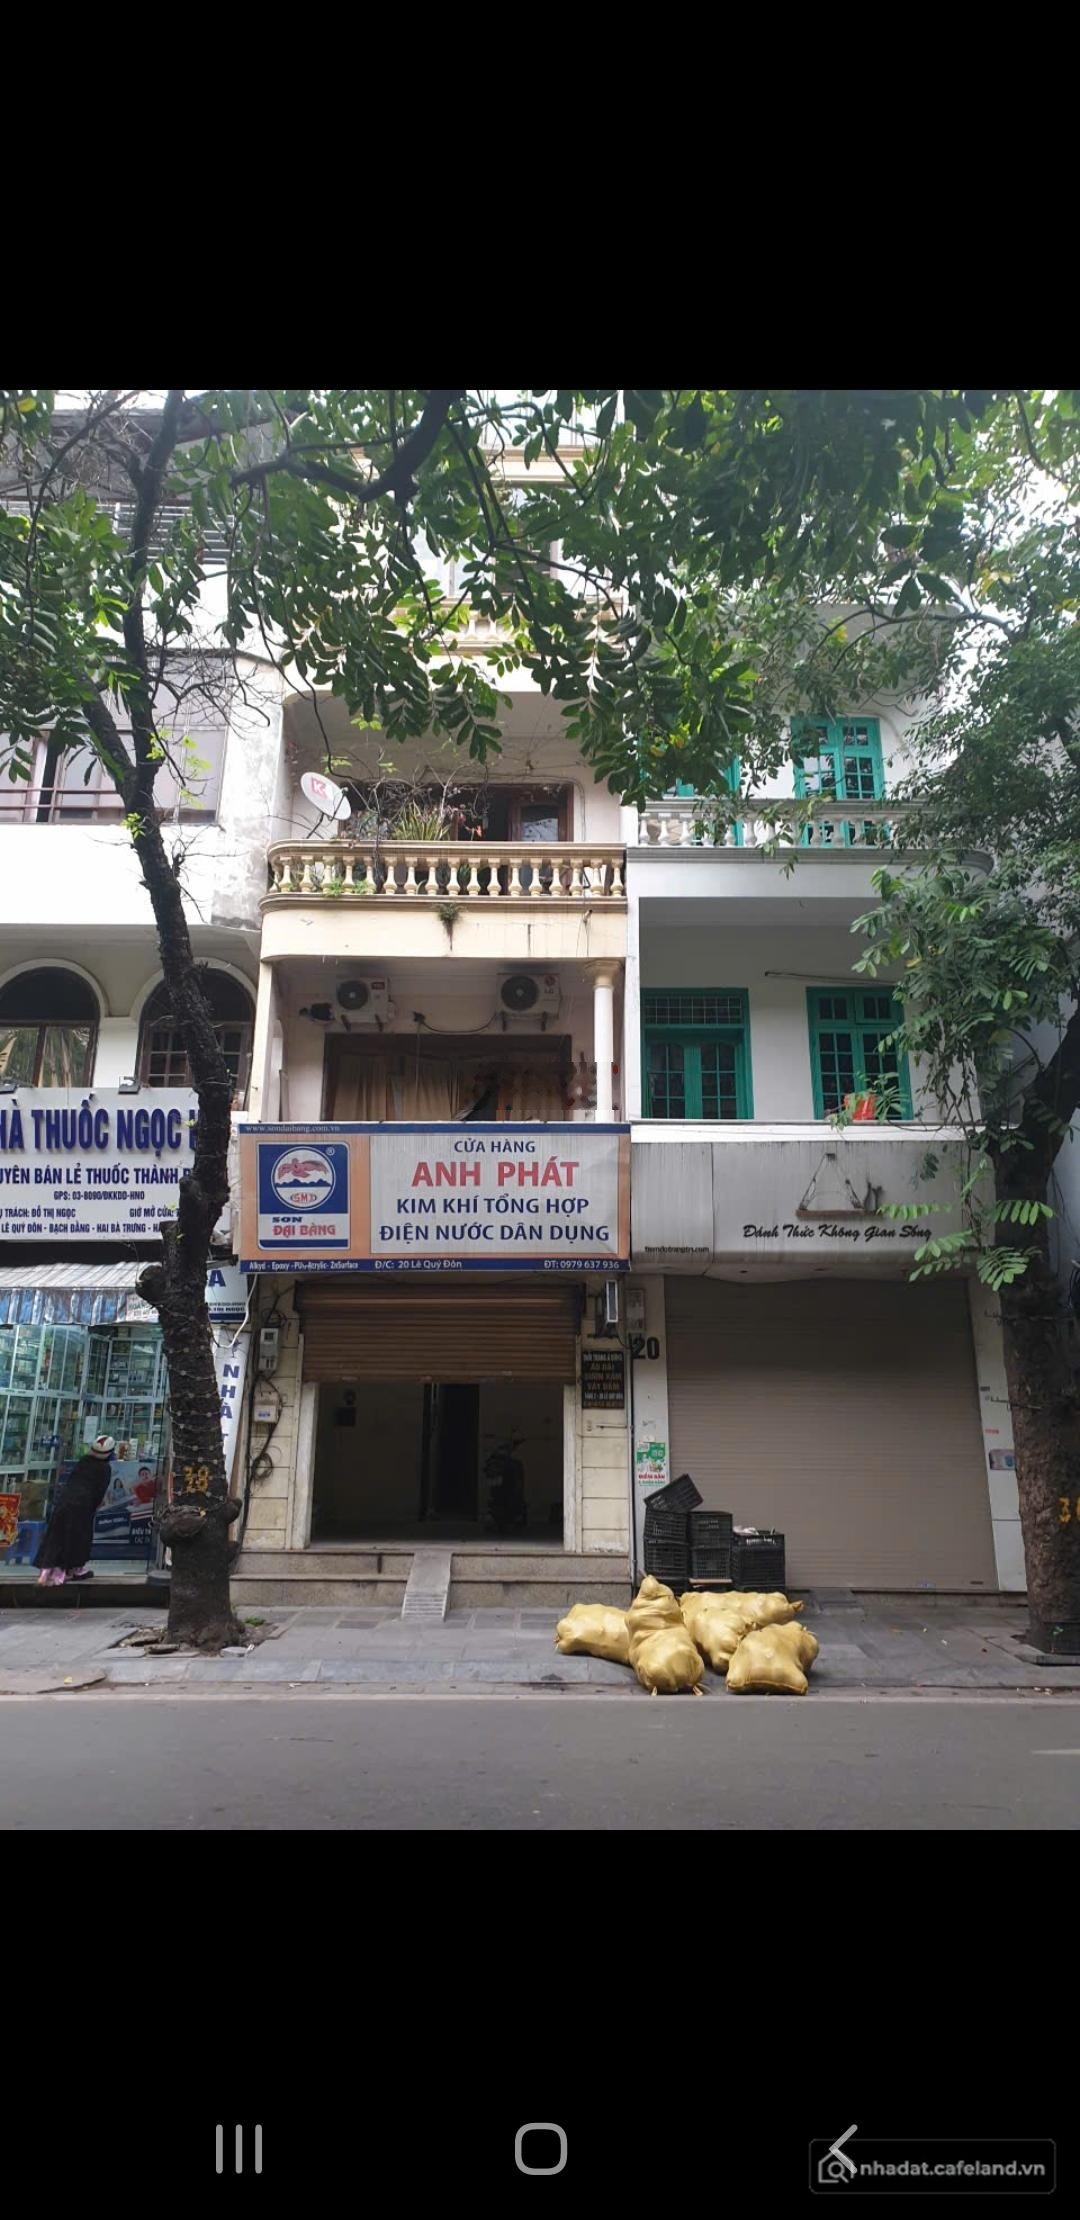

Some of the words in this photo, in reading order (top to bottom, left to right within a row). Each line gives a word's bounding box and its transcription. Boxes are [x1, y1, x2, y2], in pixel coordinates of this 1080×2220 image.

[31, 1093, 110, 1151] THUỐC
[116, 1108, 182, 1157] NGỌC
[454, 1139, 487, 1154] CỬA
[490, 1139, 536, 1153] HÀNG
[34, 1165, 62, 1184] BÁN
[66, 1163, 82, 1184] LẺ
[86, 1163, 130, 1184] THUỐC
[133, 1164, 179, 1184] THÀNH
[411, 1161, 481, 1187] ANH
[497, 1156, 580, 1187] PHÁT
[397, 1198, 436, 1213] KIM
[442, 1195, 478, 1213] KHÍ
[483, 1193, 539, 1214] TỔNG
[546, 1198, 589, 1217] HỢP
[272, 1225, 296, 1238] ĐẠI
[299, 1222, 336, 1236] BÀNG
[379, 1223, 429, 1244] ĐIỆN
[435, 1222, 494, 1241] NƯỚC
[499, 1223, 542, 1241] DÂN
[549, 1225, 610, 1244] DỤNG
[743, 1224, 779, 1238] Đánh
[818, 1224, 860, 1241] Không
[864, 1225, 896, 1242] Gian
[398, 1260, 410, 1269] 20
[411, 1260, 422, 1269] Lê
[423, 1260, 442, 1272] Quý
[443, 1260, 462, 1269] Đôn
[560, 1259, 582, 1269] 0979
[584, 1259, 600, 1269] 637
[602, 1260, 620, 1269] 936
[208, 1269, 226, 1287] A
[632, 1336, 660, 1360] 20
